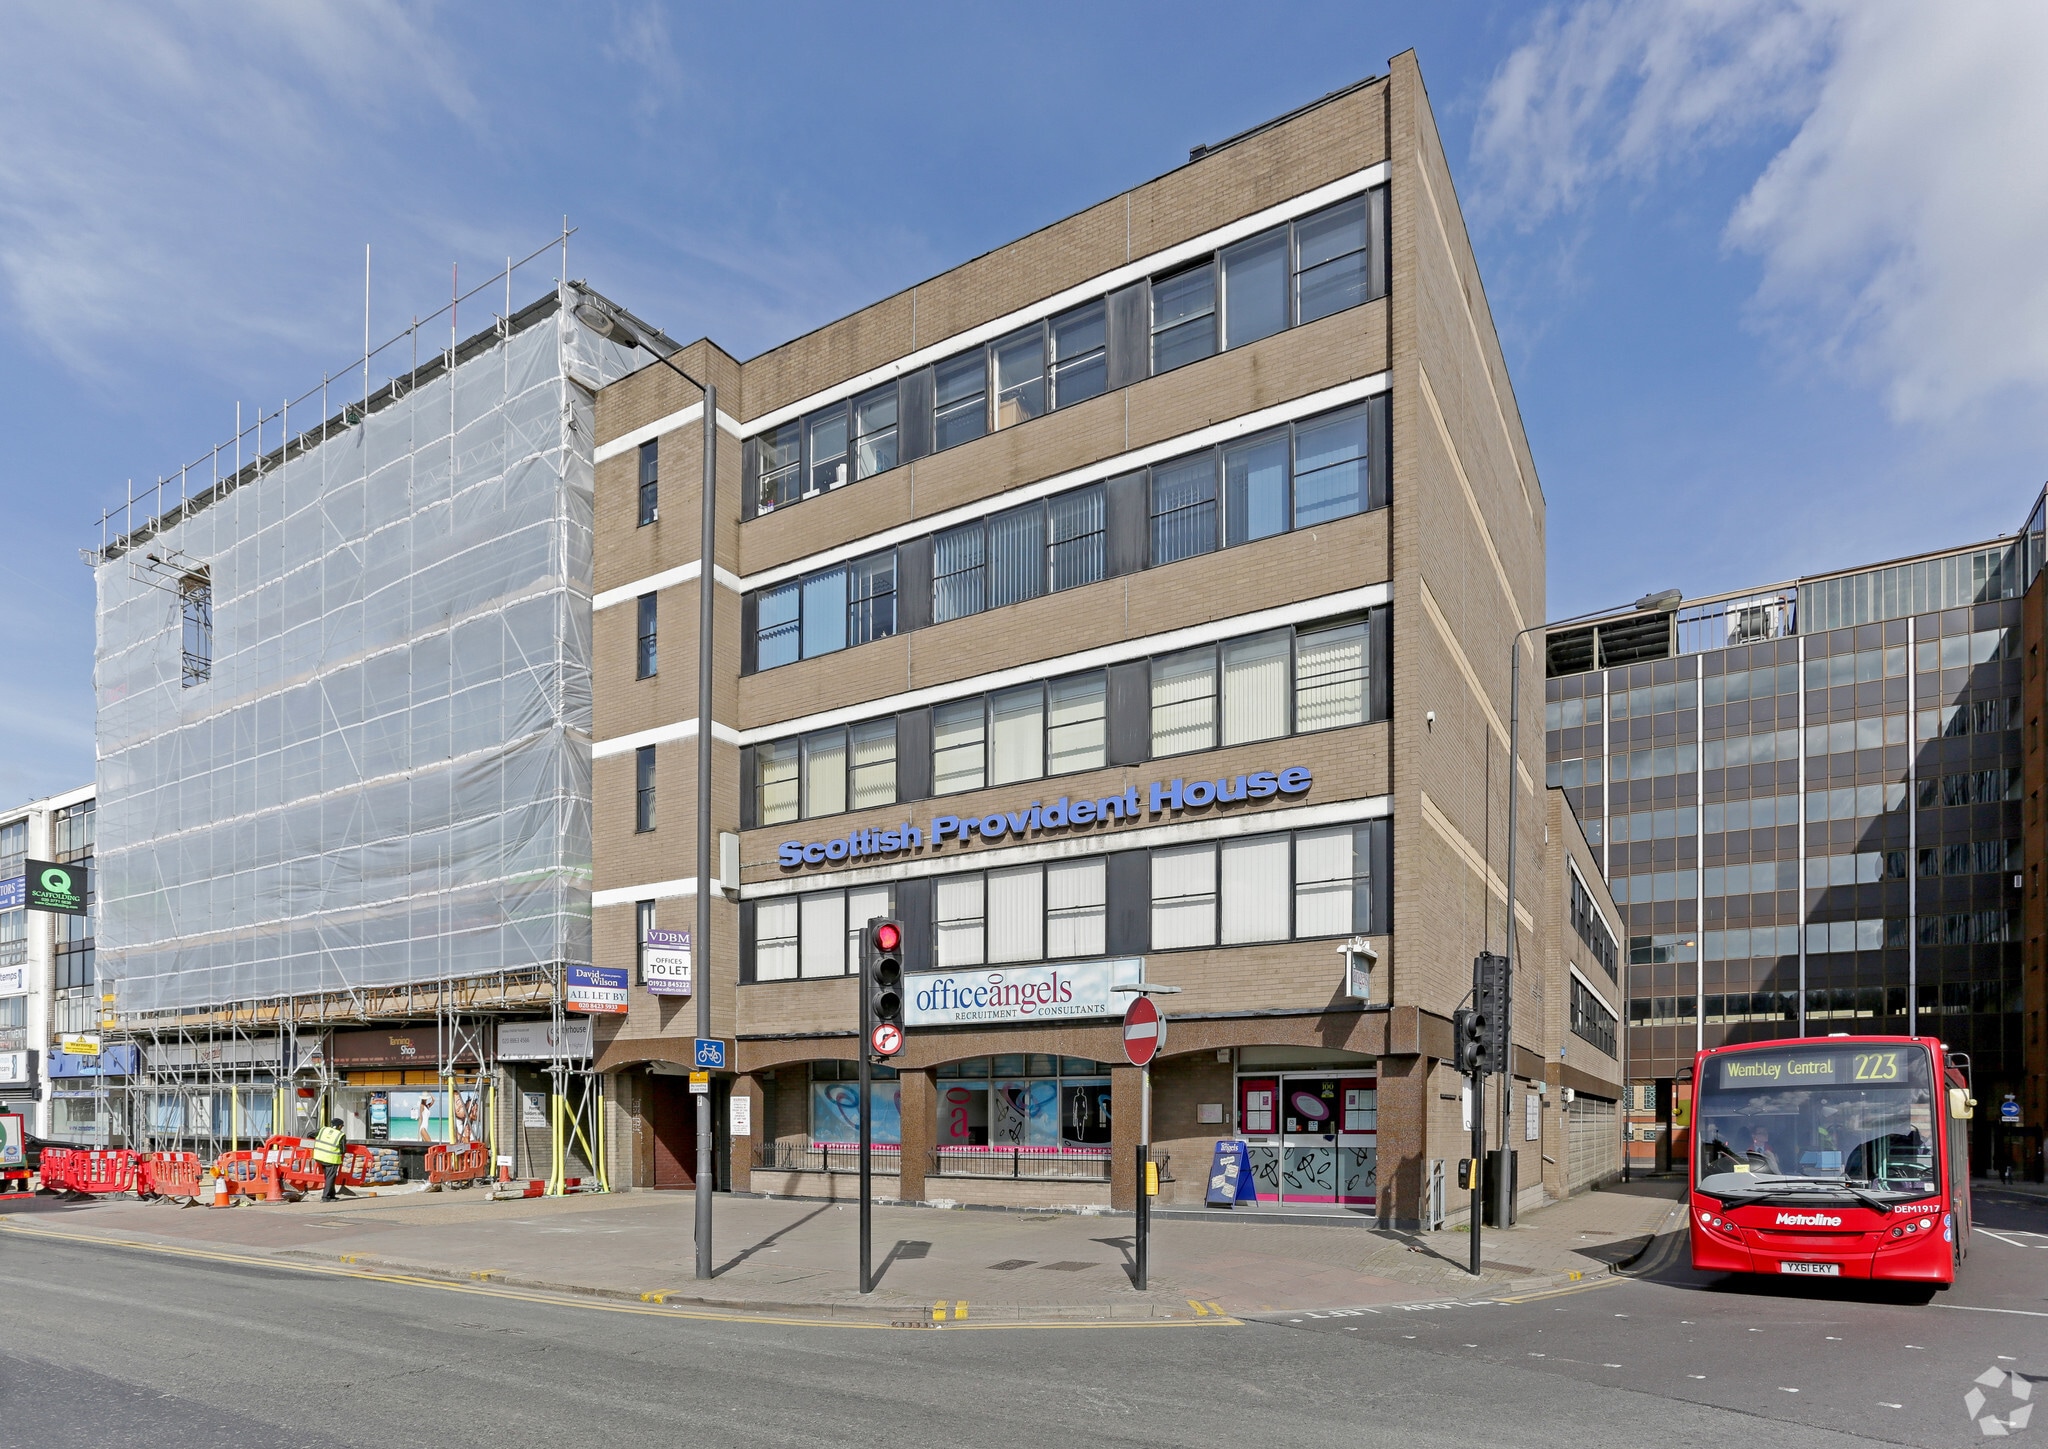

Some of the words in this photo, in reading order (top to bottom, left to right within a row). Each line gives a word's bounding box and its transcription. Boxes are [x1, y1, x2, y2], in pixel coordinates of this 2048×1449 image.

[778, 822, 922, 867] Scottish
[931, 784, 1141, 845] Provident
[1149, 766, 1312, 814] House
[41, 868, 72, 895] Q
[32, 890, 80, 902] SCAFFOLDING
[648, 931, 690, 943] VDBM
[655, 957, 683, 965] OFFICES
[576, 969, 600, 978] David
[650, 964, 666, 974] TO
[669, 965, 689, 975] LET
[590, 977, 618, 987] Wilson
[570, 990, 590, 999] ALL
[592, 991, 610, 1000] LET
[613, 993, 626, 1001] BY
[955, 1009, 1017, 1020] RECRUITMENT
[1038, 1004, 1105, 1016] CONSULTANTS
[388, 1035, 411, 1047] Tanning
[400, 1045, 416, 1057] Shop
[1727, 1062, 1781, 1080] Wembley
[1787, 1058, 1833, 1075] Central
[1855, 1053, 1897, 1080] 223
[1894, 1205, 1940, 1213] DEM1917
[1776, 1213, 1842, 1227] Metroline
[1787, 1263, 1810, 1272] YX61
[1812, 1264, 1832, 1274] EKY
